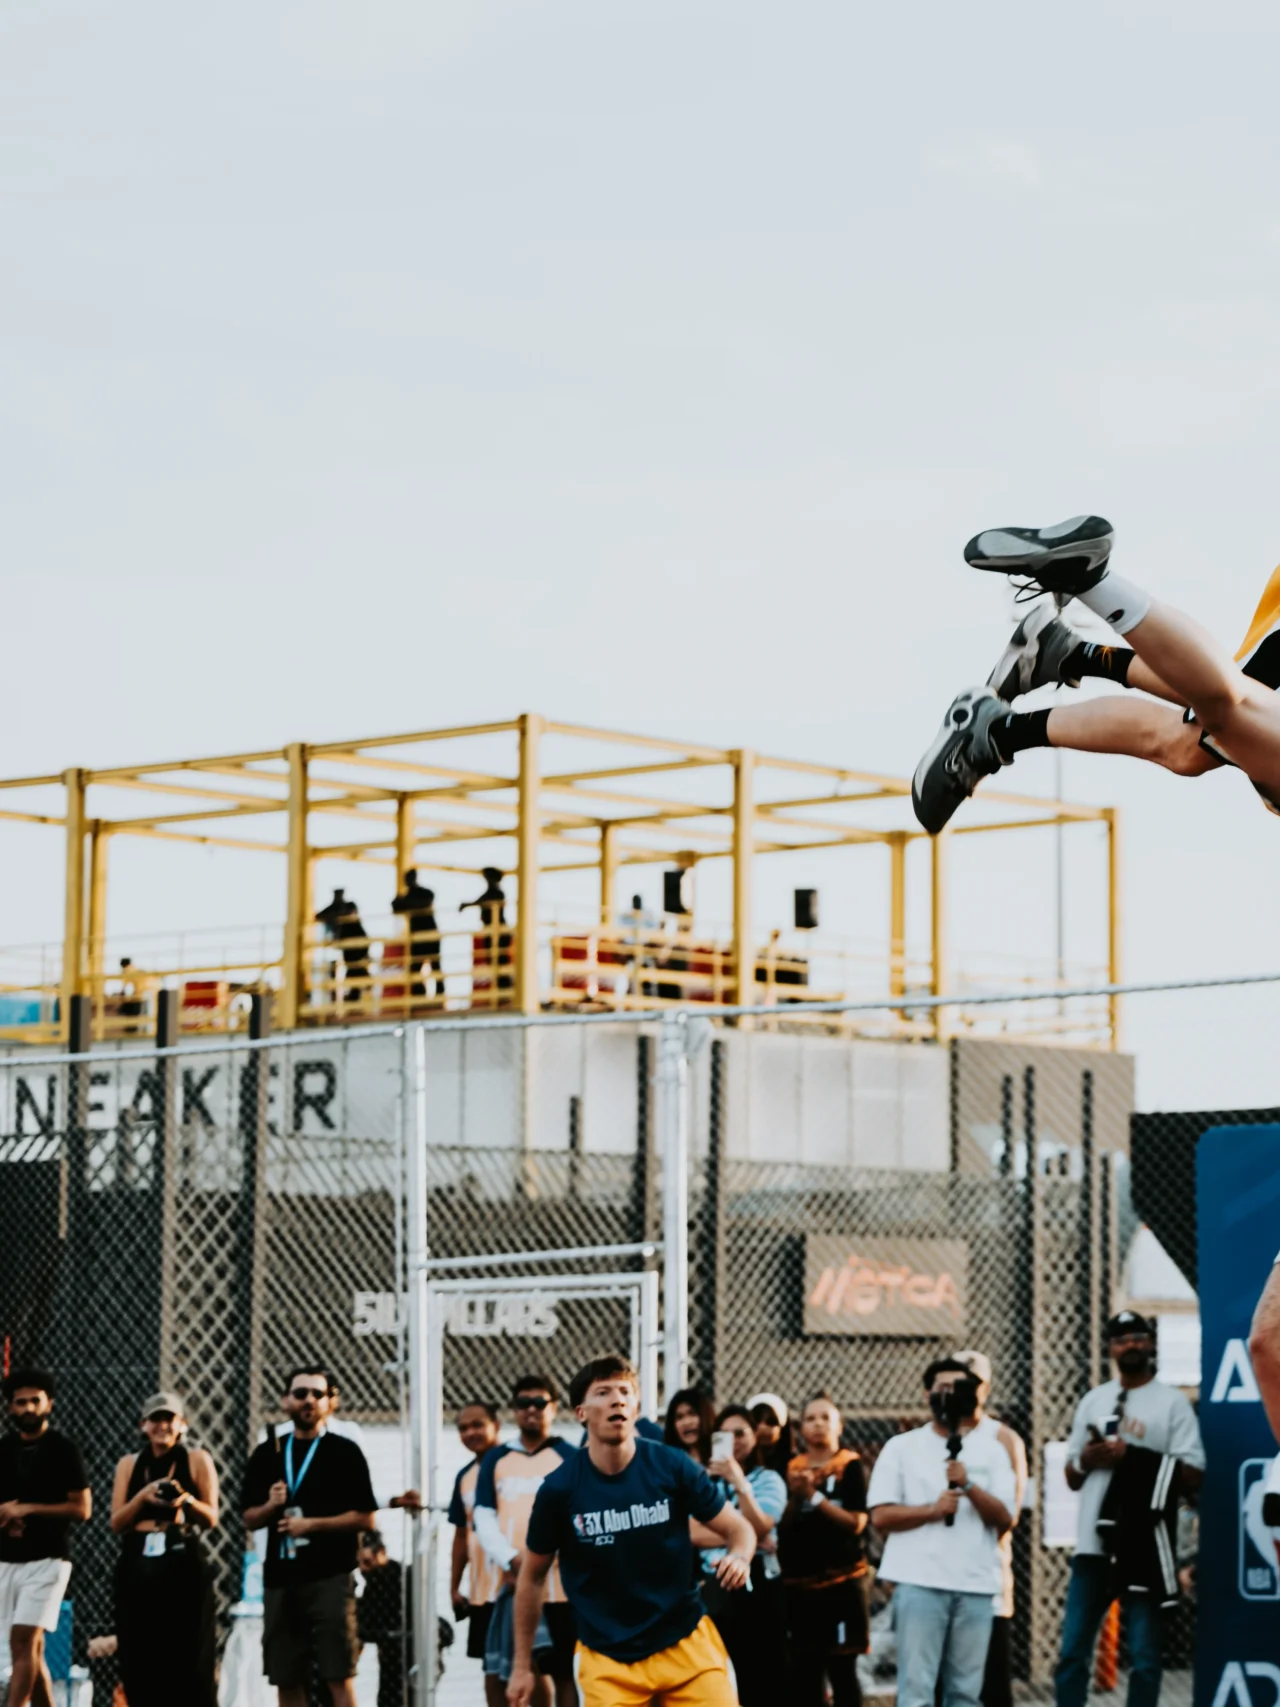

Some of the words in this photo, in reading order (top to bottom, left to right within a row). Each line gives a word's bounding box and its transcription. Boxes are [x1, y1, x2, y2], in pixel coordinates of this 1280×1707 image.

[583, 1511, 604, 1536] 3X
[603, 1508, 631, 1533] Abu
[630, 1498, 670, 1528] Dhabi
